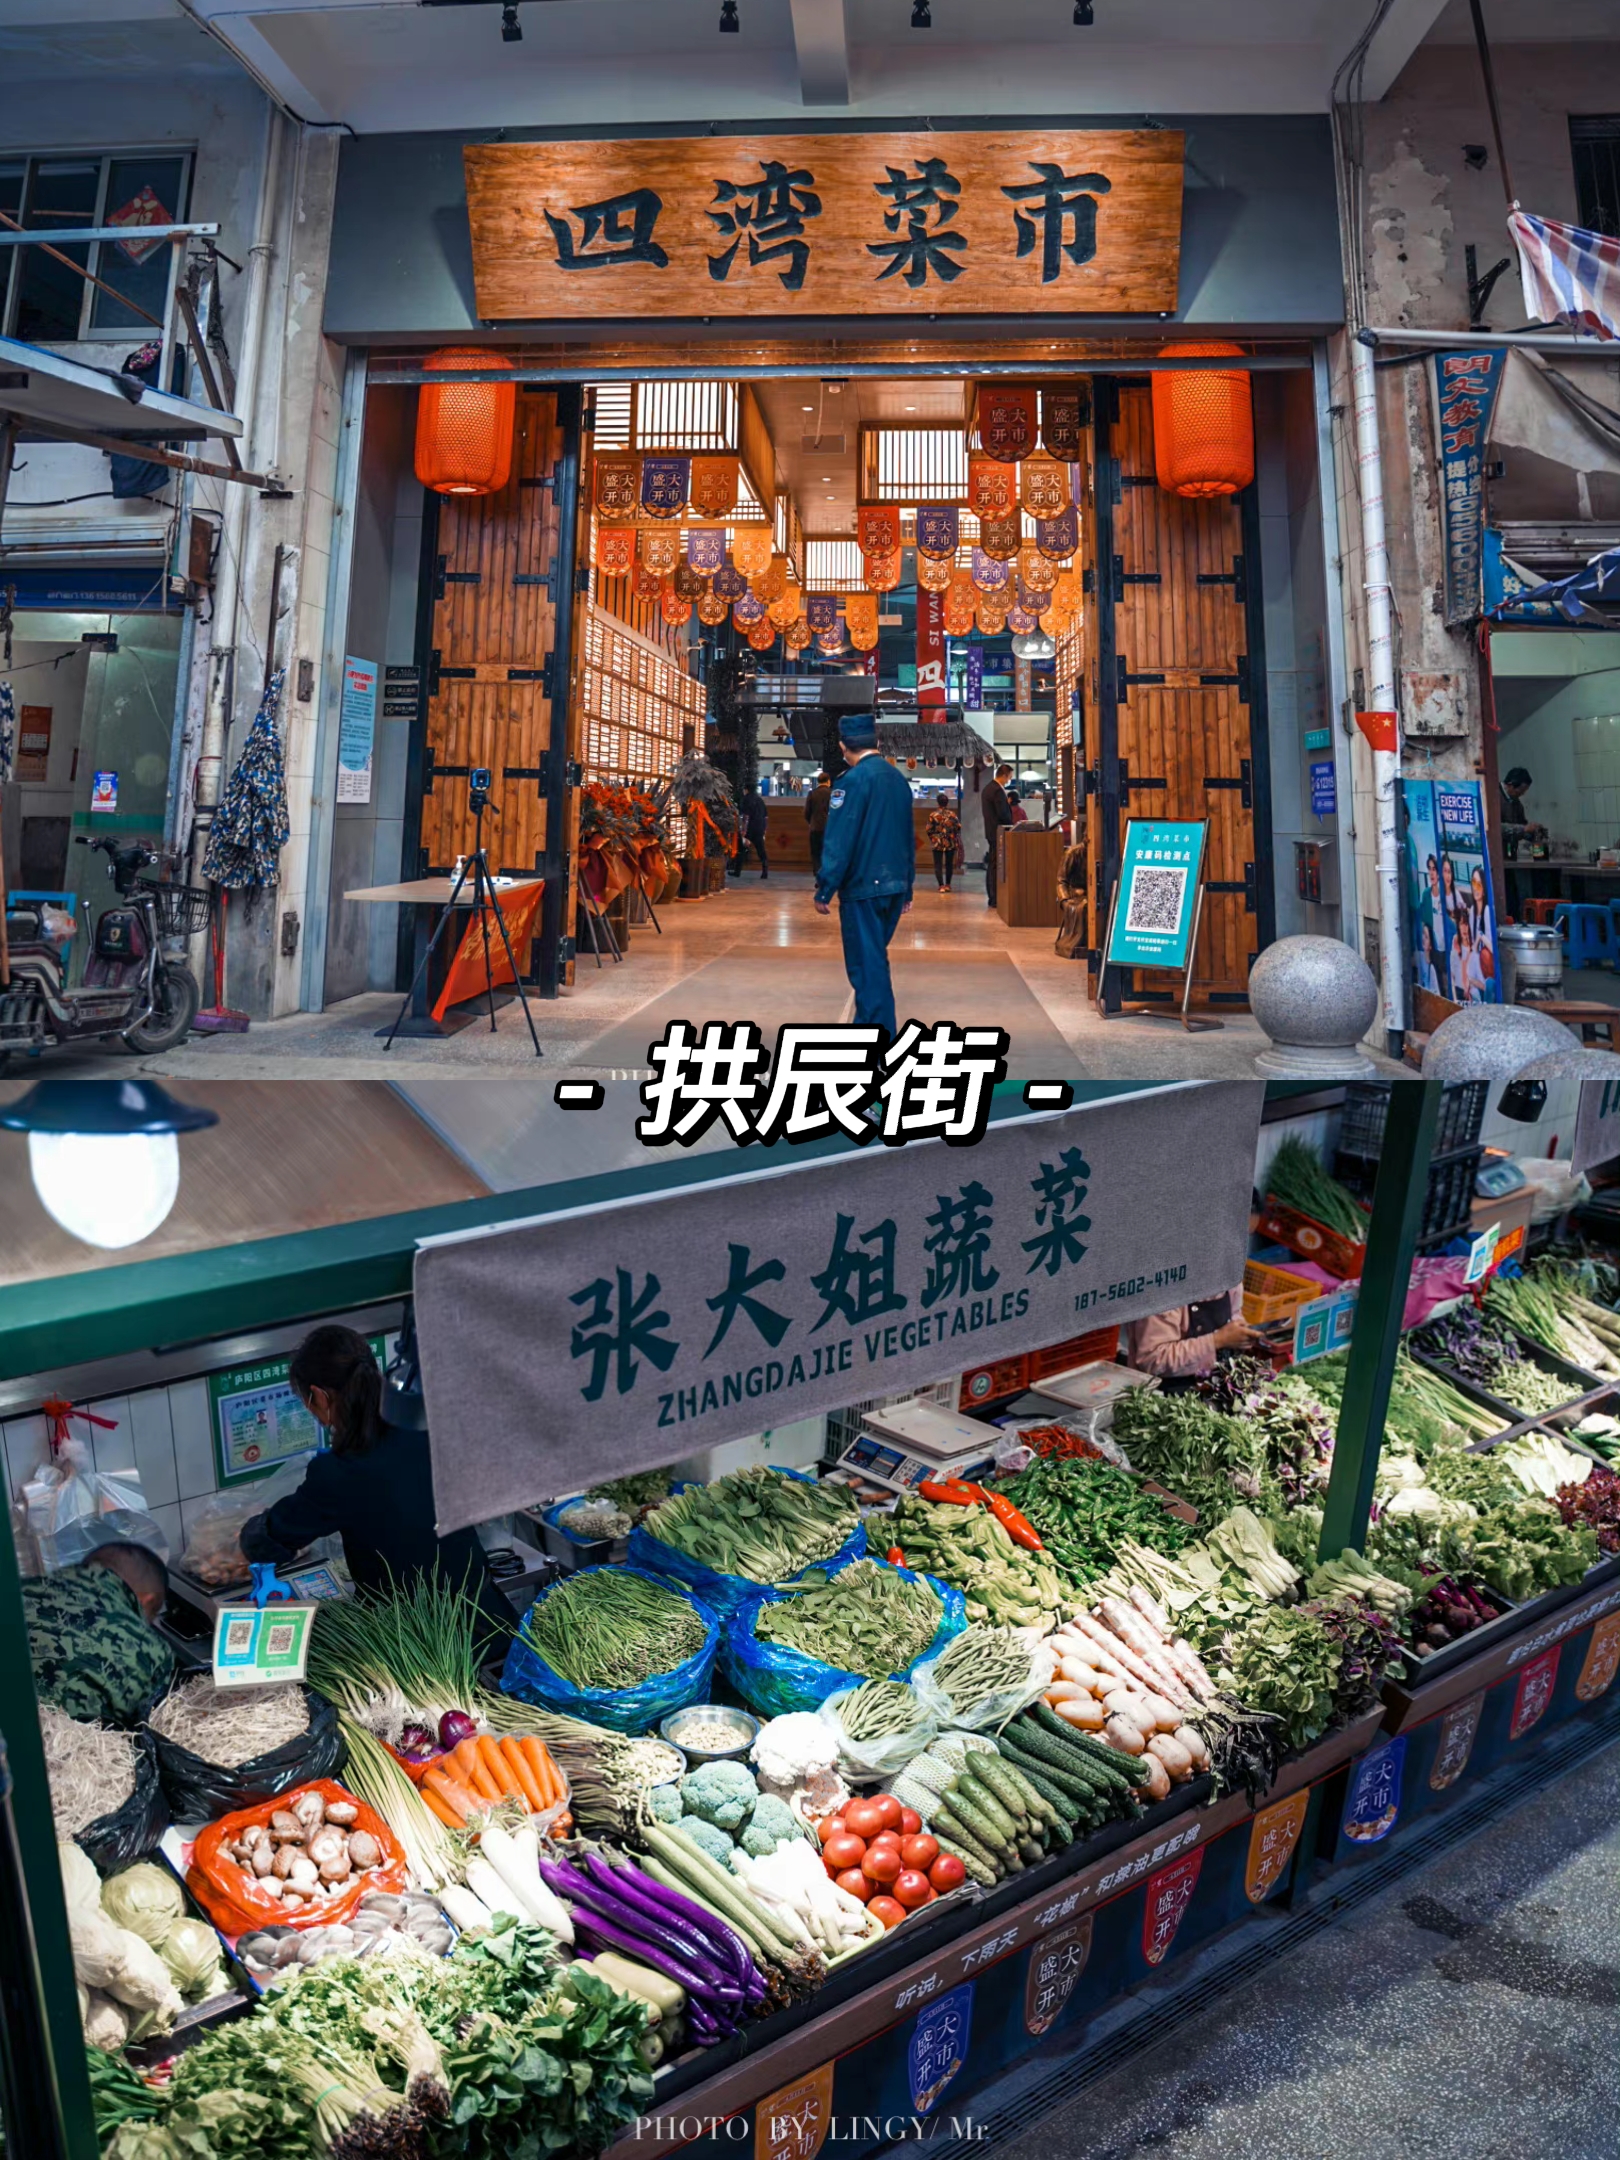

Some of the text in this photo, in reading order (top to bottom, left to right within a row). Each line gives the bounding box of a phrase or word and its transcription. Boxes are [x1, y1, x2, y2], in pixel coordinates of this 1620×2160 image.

[544, 157, 1112, 290] 四湾菜市
[917, 660, 945, 692] 四
[1441, 795, 1472, 809] EXERCISE
[1459, 811, 1475, 823] LIFE
[567, 1147, 1091, 1402] 张大姐蔬菜
[1073, 1264, 1188, 1311] 187-5602-4140
[657, 1288, 1030, 1428] ZHANGDAJIE VEGETABLES
[1596, 1633, 1620, 1660] 盛大
[1588, 1654, 1614, 1680] 开市
[1524, 1672, 1550, 1703] 盛大
[1520, 1696, 1544, 1722] 开市
[1448, 1718, 1474, 1749] 盛大
[1440, 1741, 1467, 1775] 开市
[1359, 1763, 1392, 1794] 盛大
[1353, 1788, 1390, 1819] 开市
[1262, 1820, 1296, 1853] 盛大
[1258, 1846, 1290, 1879] 开市
[1157, 1878, 1192, 1916] 盛大
[1155, 1904, 1186, 1942] 开市
[961, 1926, 1019, 1972] 下雨天
[1039, 1946, 1080, 1984] 盛大
[1039, 1973, 1076, 2012] 开市
[916, 2016, 958, 2061] 盛大
[917, 2042, 955, 2088] 开市
[766, 2100, 818, 2147] 盛大
